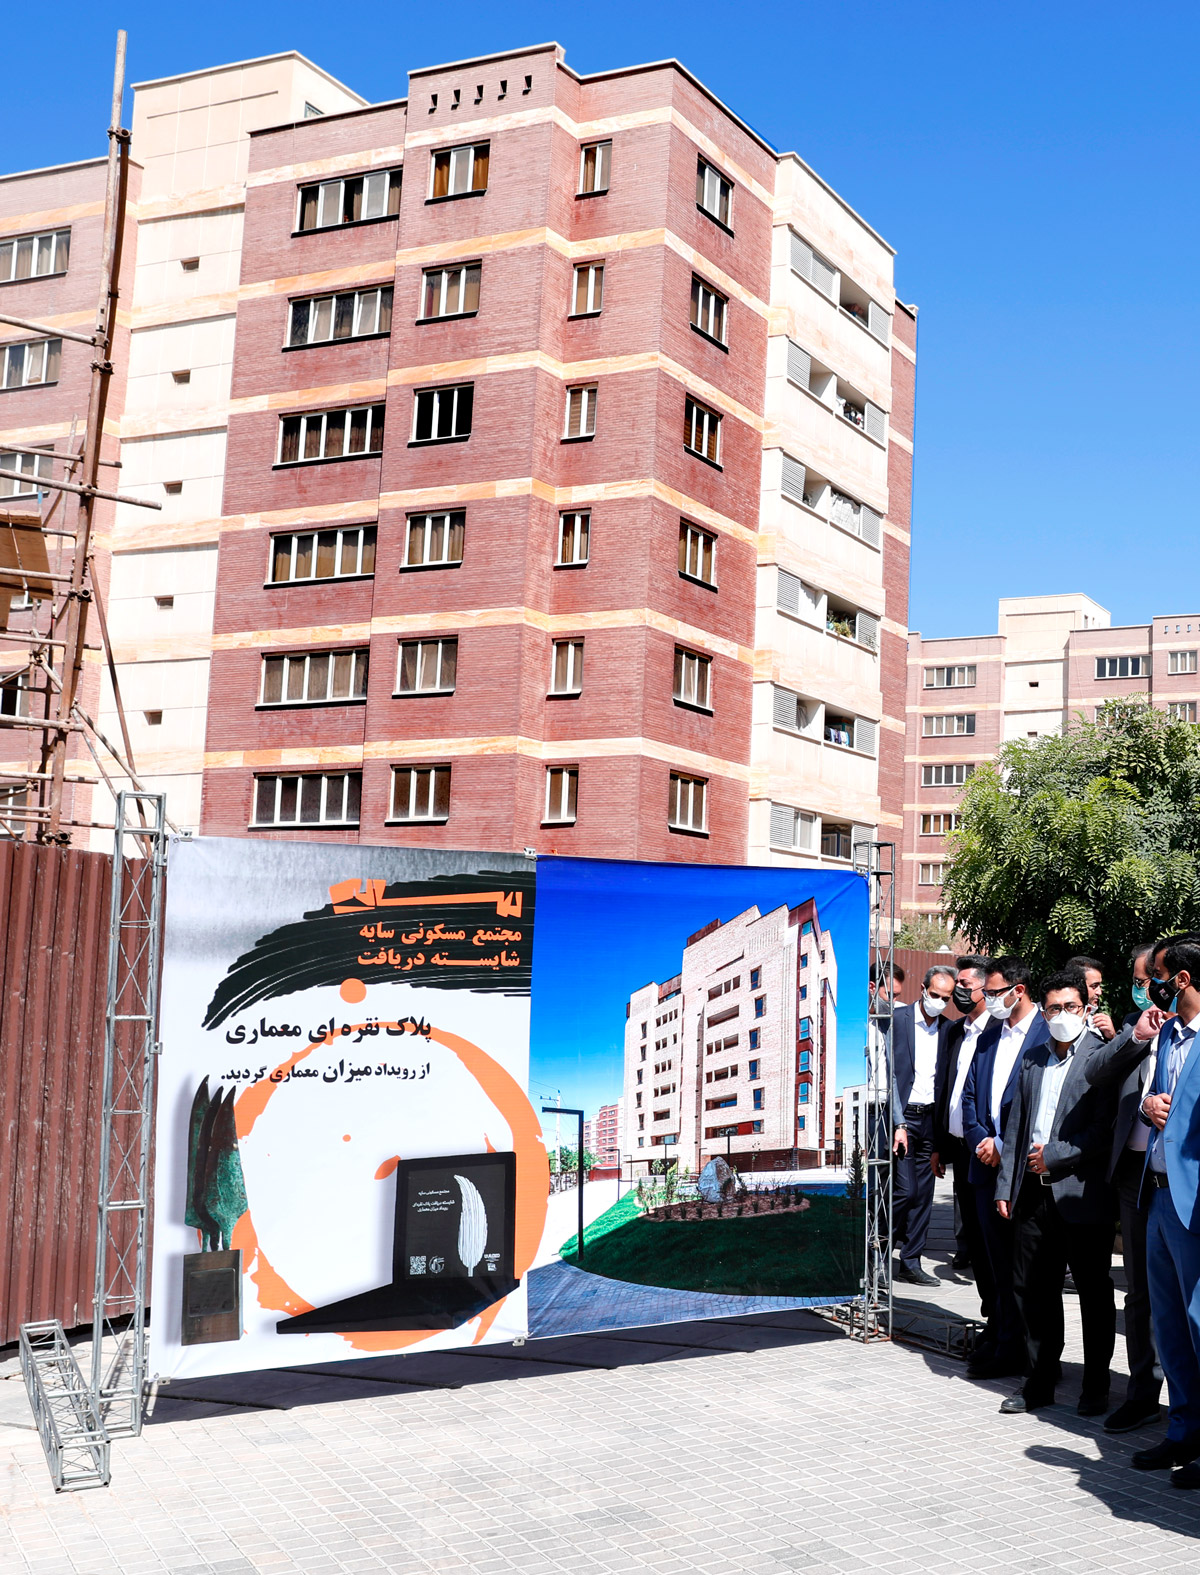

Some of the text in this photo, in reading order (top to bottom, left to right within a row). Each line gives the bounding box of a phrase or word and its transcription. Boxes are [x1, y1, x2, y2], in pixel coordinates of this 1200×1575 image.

[359, 921, 522, 946] مجتمع مسکونی سایه
[357, 947, 521, 971] شایسته دریافت
[225, 1015, 432, 1045] پلاک نقره ای معماری
[269, 1064, 319, 1083] معماری
[322, 1058, 372, 1083] میزان
[374, 1062, 416, 1080] رویداد
[418, 1062, 430, 1080] از
